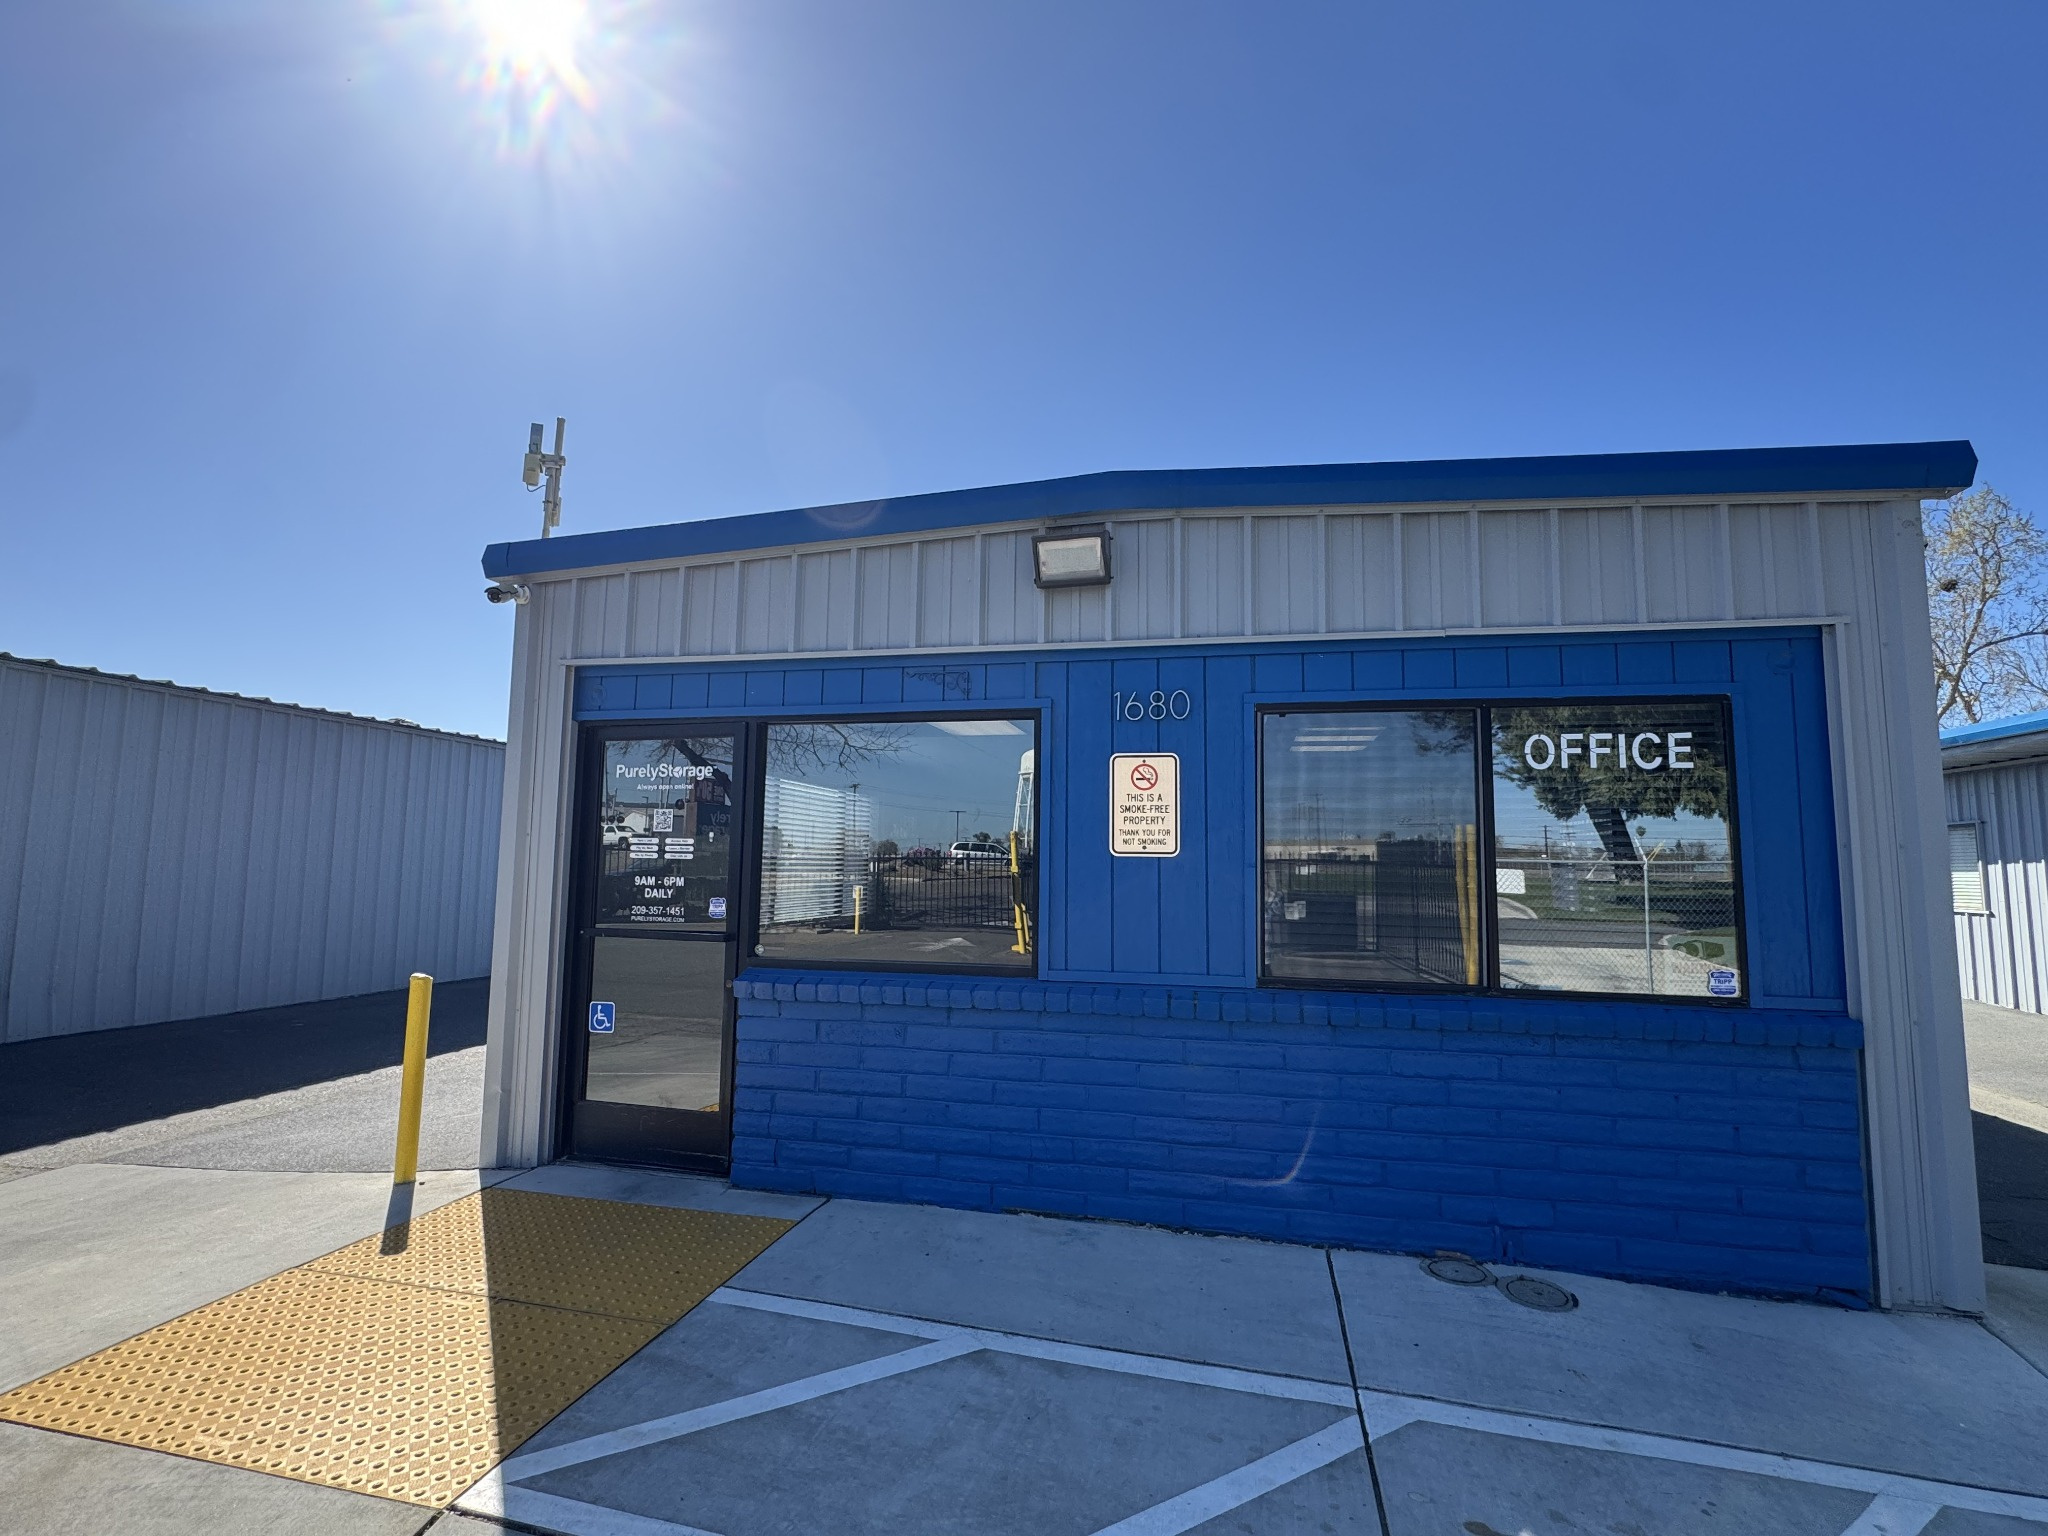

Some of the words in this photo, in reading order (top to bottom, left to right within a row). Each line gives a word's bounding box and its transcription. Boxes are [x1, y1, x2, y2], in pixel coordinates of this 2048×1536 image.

[1113, 689, 1190, 721] 1680
[1524, 732, 1694, 770] OFFICE
[616, 764, 714, 781] PurelyStorage
[1126, 794, 1144, 803] THIS
[1146, 794, 1155, 803] IS
[1157, 794, 1163, 802] A
[1119, 805, 1170, 814] SMOKE-FREE
[1123, 816, 1166, 825] PROPERTY
[1119, 829, 1140, 837] THANK
[1142, 829, 1155, 837] YOU
[1157, 829, 1171, 837] FOR
[1122, 838, 1135, 846] NOT
[1137, 838, 1167, 846] SMOKING
[634, 876, 656, 886] 9AM
[663, 877, 685, 887] 6PM
[644, 888, 674, 899] DAILY
[631, 906, 685, 916] 209-357-1451
